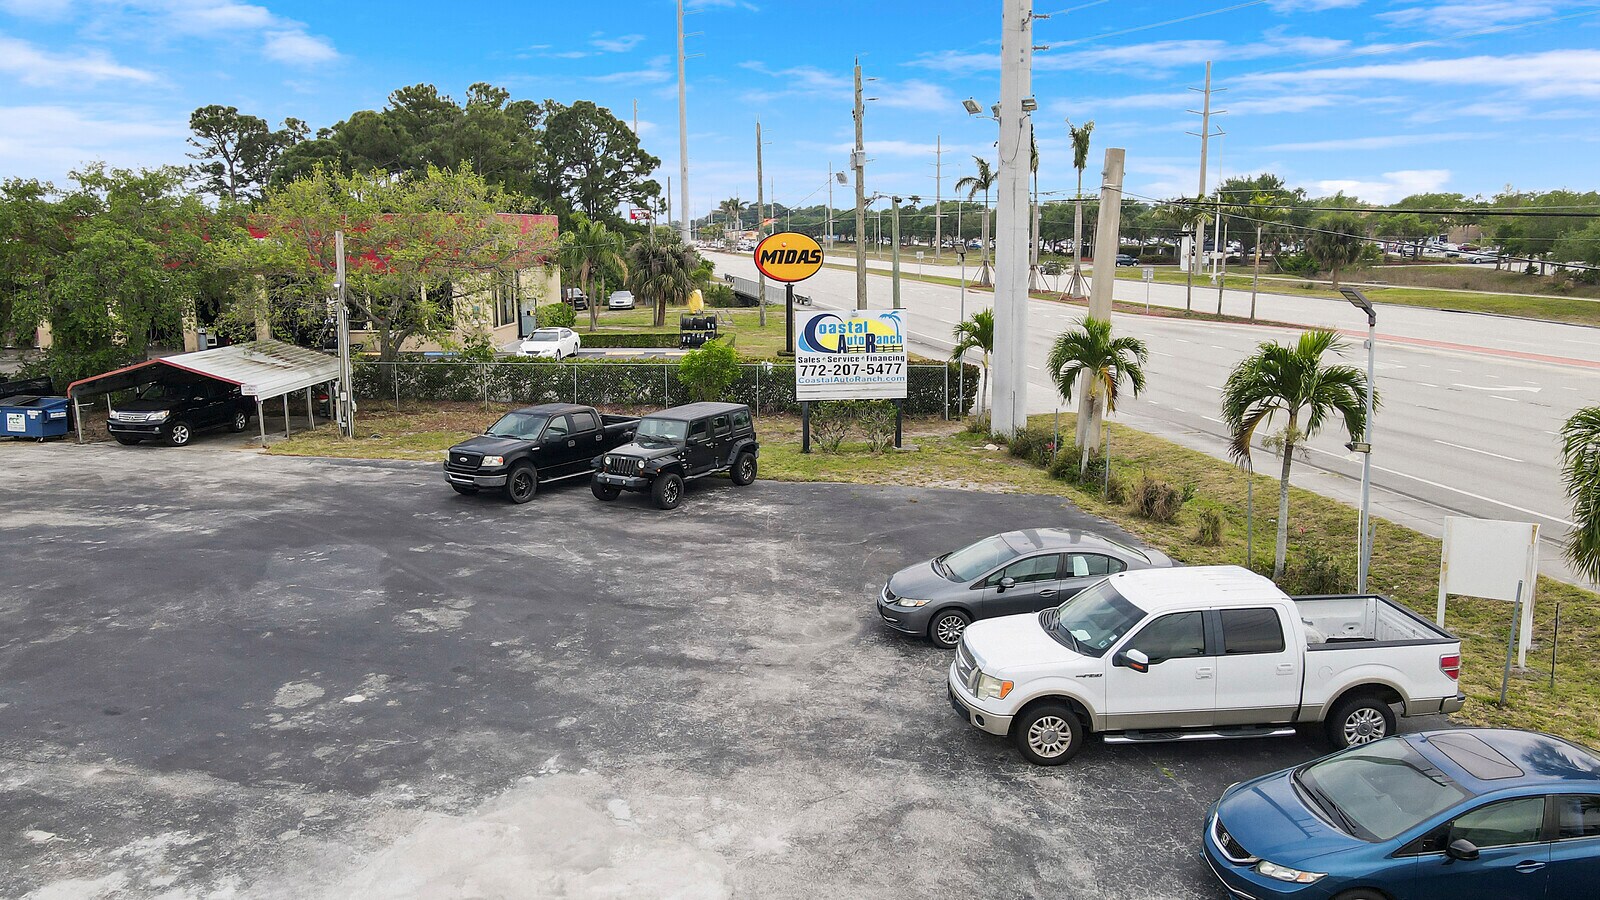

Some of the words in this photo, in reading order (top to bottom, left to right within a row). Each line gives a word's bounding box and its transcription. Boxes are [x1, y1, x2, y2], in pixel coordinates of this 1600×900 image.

[760, 249, 822, 266] MIDAS
[804, 313, 868, 353] Coastal
[798, 356, 821, 364] Sales
[827, 355, 860, 363] Service
[866, 355, 905, 363] Financing
[800, 363, 902, 377] 772-207-5477
[798, 375, 905, 384] CoastalAutoRanch.com
